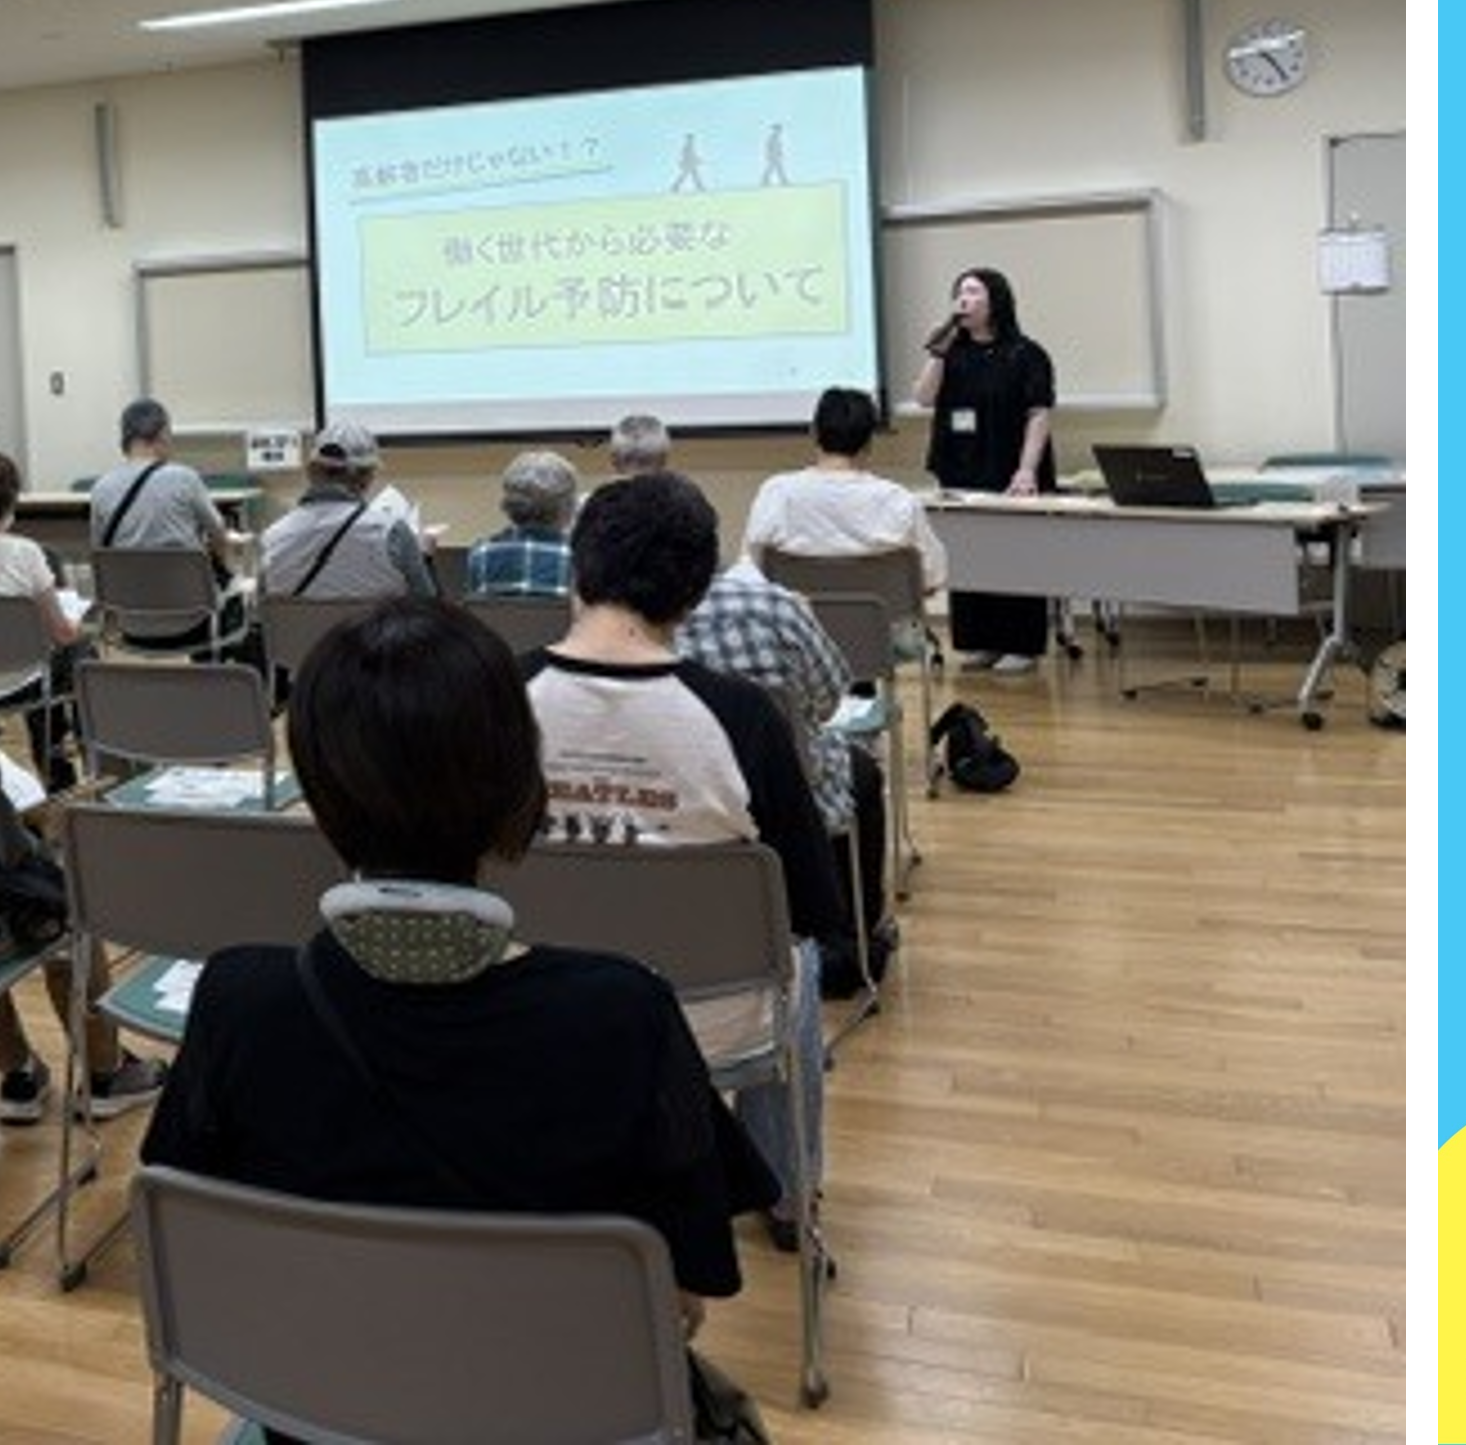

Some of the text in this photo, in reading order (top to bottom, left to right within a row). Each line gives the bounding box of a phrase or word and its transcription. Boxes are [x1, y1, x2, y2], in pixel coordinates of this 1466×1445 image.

[443, 220, 731, 267] 働く世代から必要な
[394, 264, 825, 328] フレイル予防について
